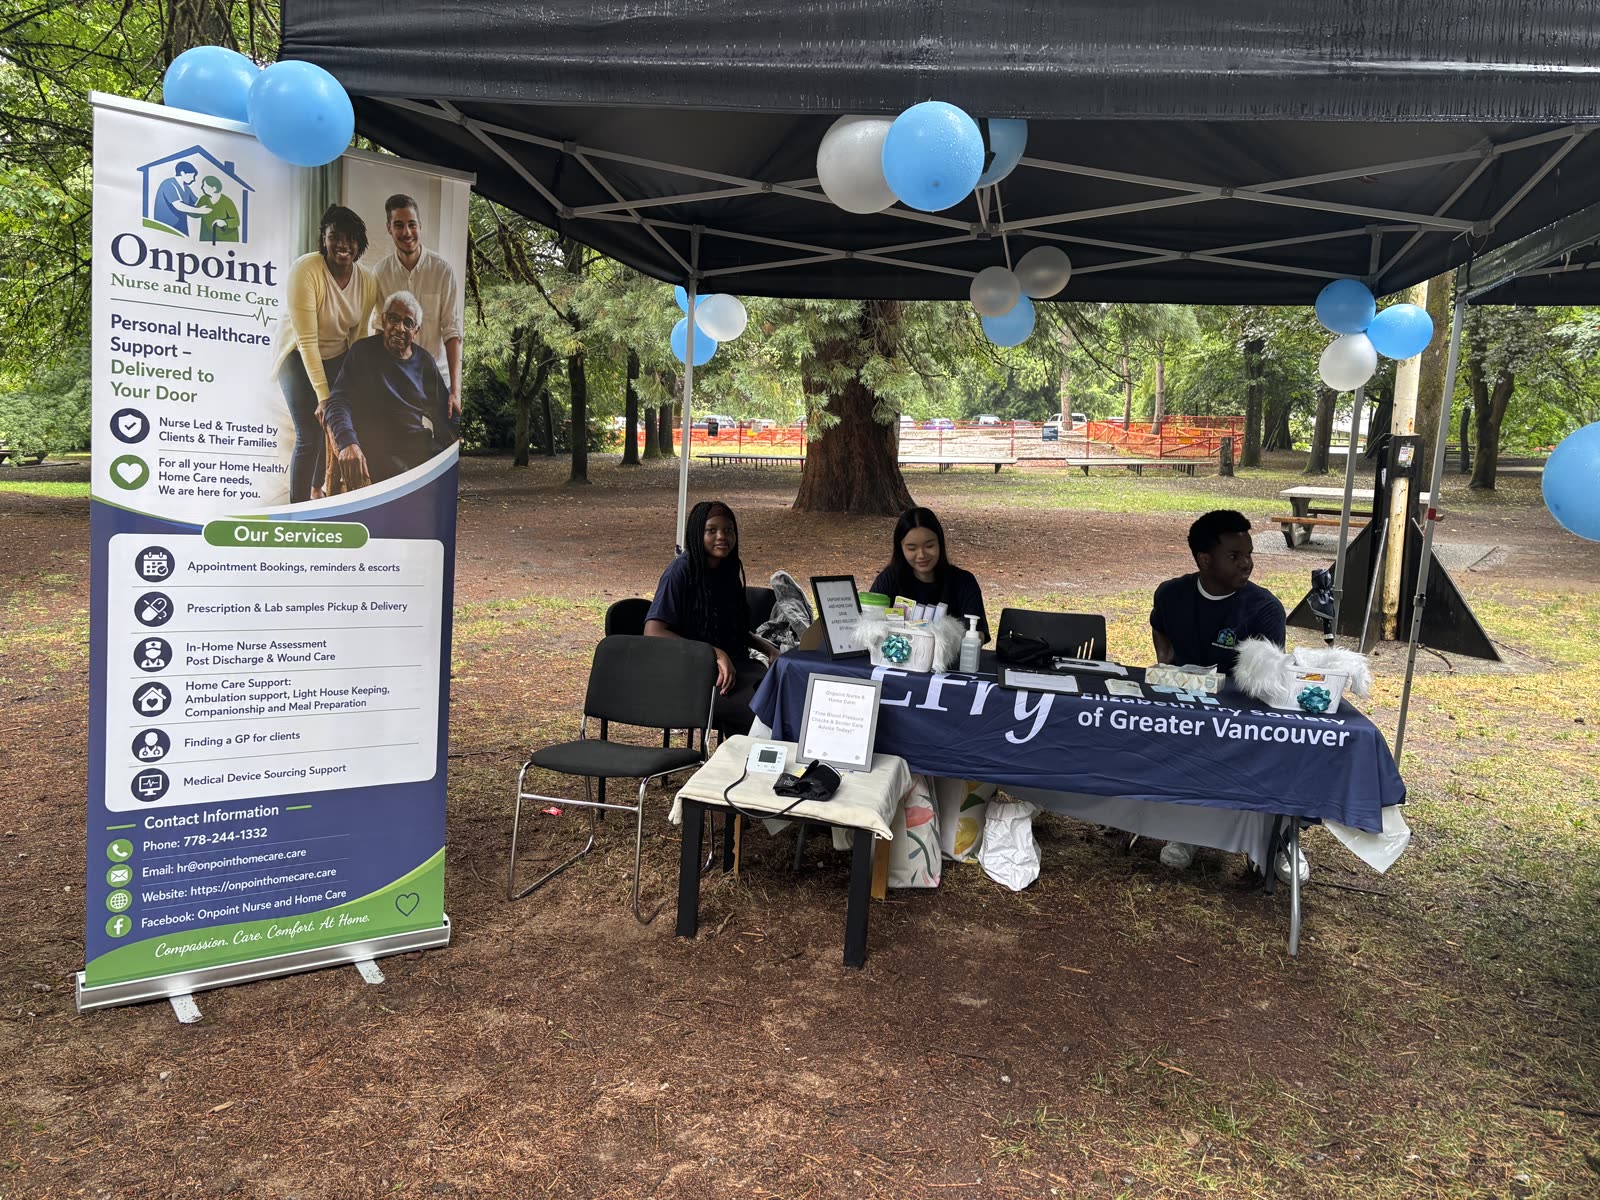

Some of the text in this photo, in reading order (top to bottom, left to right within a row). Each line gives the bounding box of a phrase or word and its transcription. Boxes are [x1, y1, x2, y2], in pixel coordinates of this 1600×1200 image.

[111, 233, 277, 286] Onpoint
[110, 273, 278, 306] Nurse and Home Care
[112, 314, 270, 345] Personal Healthcare
[111, 337, 178, 358] Support
[112, 359, 214, 382] Delivered to
[111, 381, 197, 402] Your Door
[160, 417, 278, 436] Nurse Led & Trusted by
[159, 431, 277, 448] Clients & Their Families
[159, 458, 289, 474] For all your Home Health/
[159, 472, 252, 486] Home Care needs,
[159, 485, 260, 500] We are here for you.
[234, 526, 342, 543] Our Services
[188, 561, 400, 573] Appointment Bookings, reminders & escorts
[187, 602, 407, 615] Prescription & Lab samples Pickup & Delivery
[186, 640, 327, 652] In-Home Nurse Assessment
[186, 652, 336, 667] Post Discharge & Wound Care
[185, 686, 390, 703] Ambulation support, Light House Keeping,
[186, 678, 291, 690] Home Care Support:
[185, 699, 366, 718] Companionship and Meal Preparation
[1080, 693, 1345, 725] Elizabeth Fry Society
[1078, 707, 1350, 747] of Greater Vancouver
[185, 732, 300, 748] Finding a GP for clients
[184, 764, 346, 786] Medical Device Sourcing Support
[144, 804, 279, 830] Contact Information
[143, 827, 267, 851] Phone: 778-244-1332
[143, 848, 306, 877] Email: hr@onpointhomecare.care
[142, 866, 336, 902] Website: https://onpointhomecare.care
[142, 889, 346, 928] Facebook: Onpoint Nurse and Home Care
[155, 913, 370, 957] Compassion. Care. Comfort. At Home.
